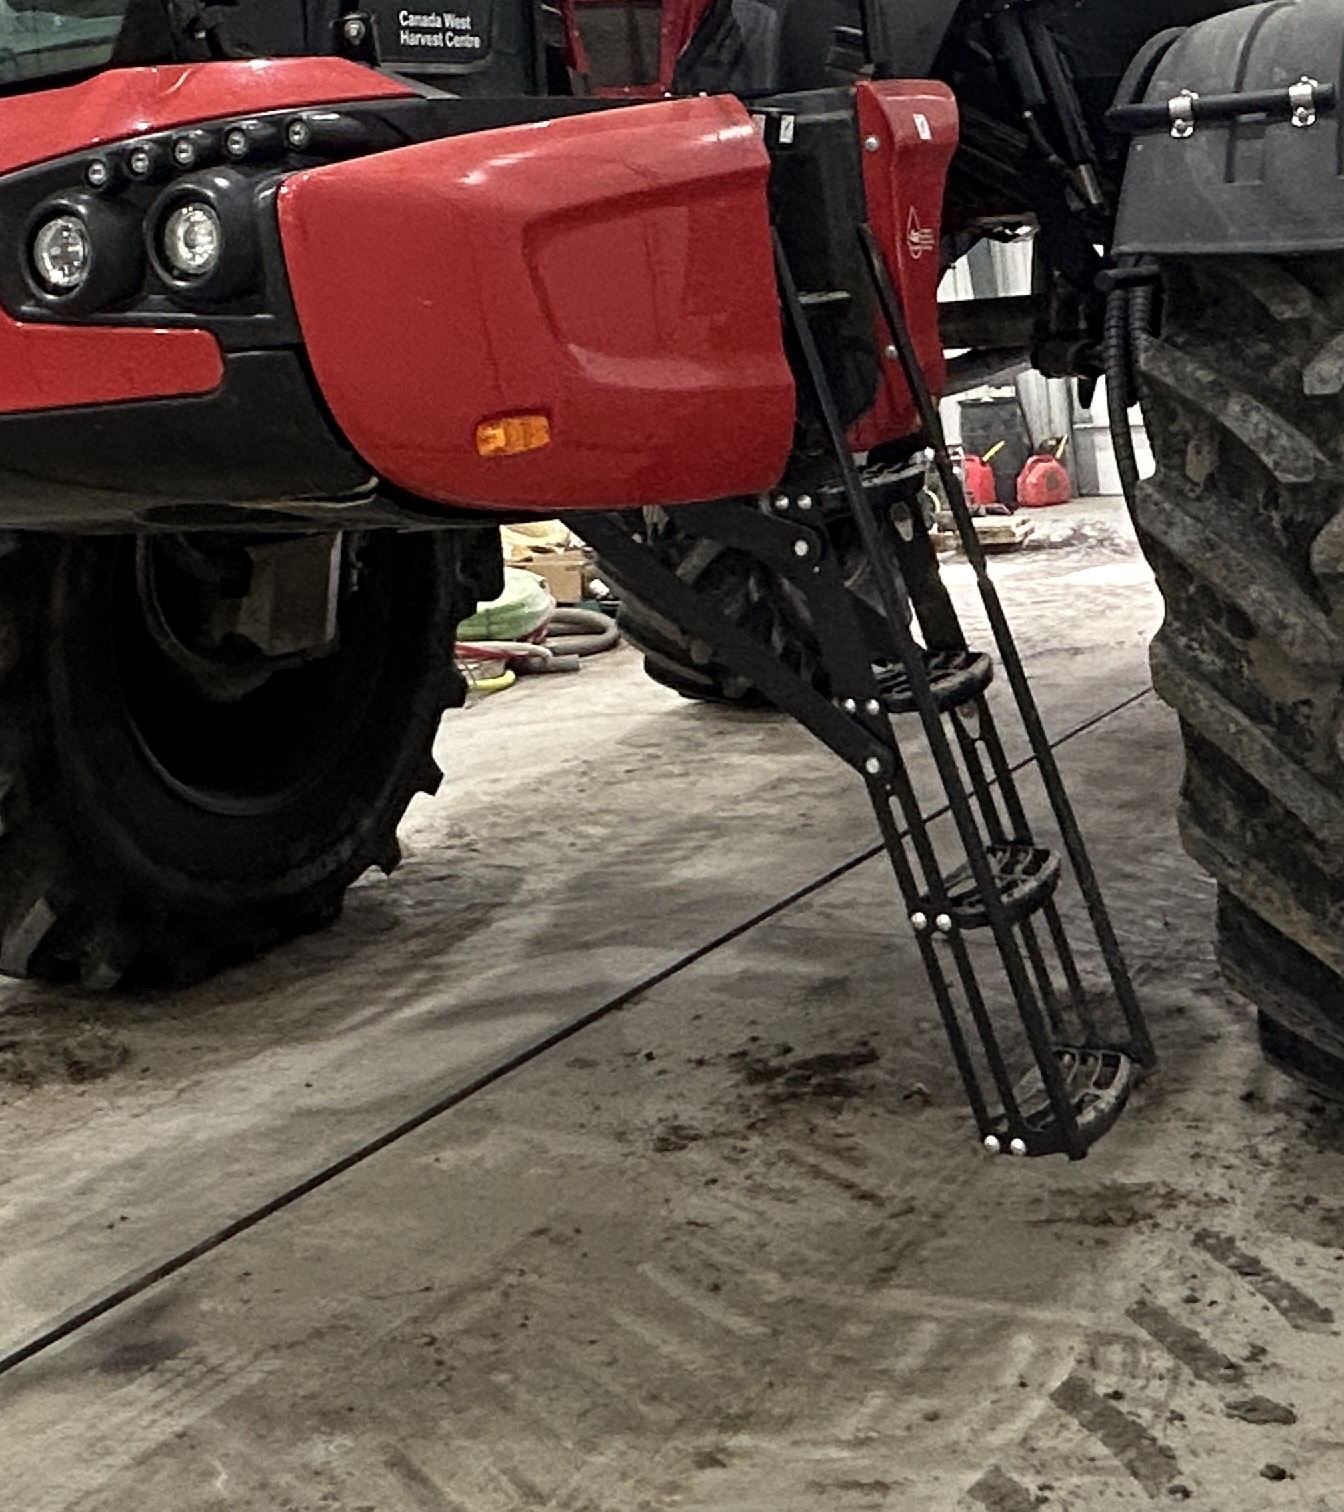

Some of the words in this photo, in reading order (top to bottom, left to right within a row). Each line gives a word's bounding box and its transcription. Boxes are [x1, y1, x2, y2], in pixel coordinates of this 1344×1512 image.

[399, 11, 442, 27] Canada
[444, 13, 471, 29] West
[401, 30, 443, 47] Harvest
[446, 31, 481, 48] Centre
